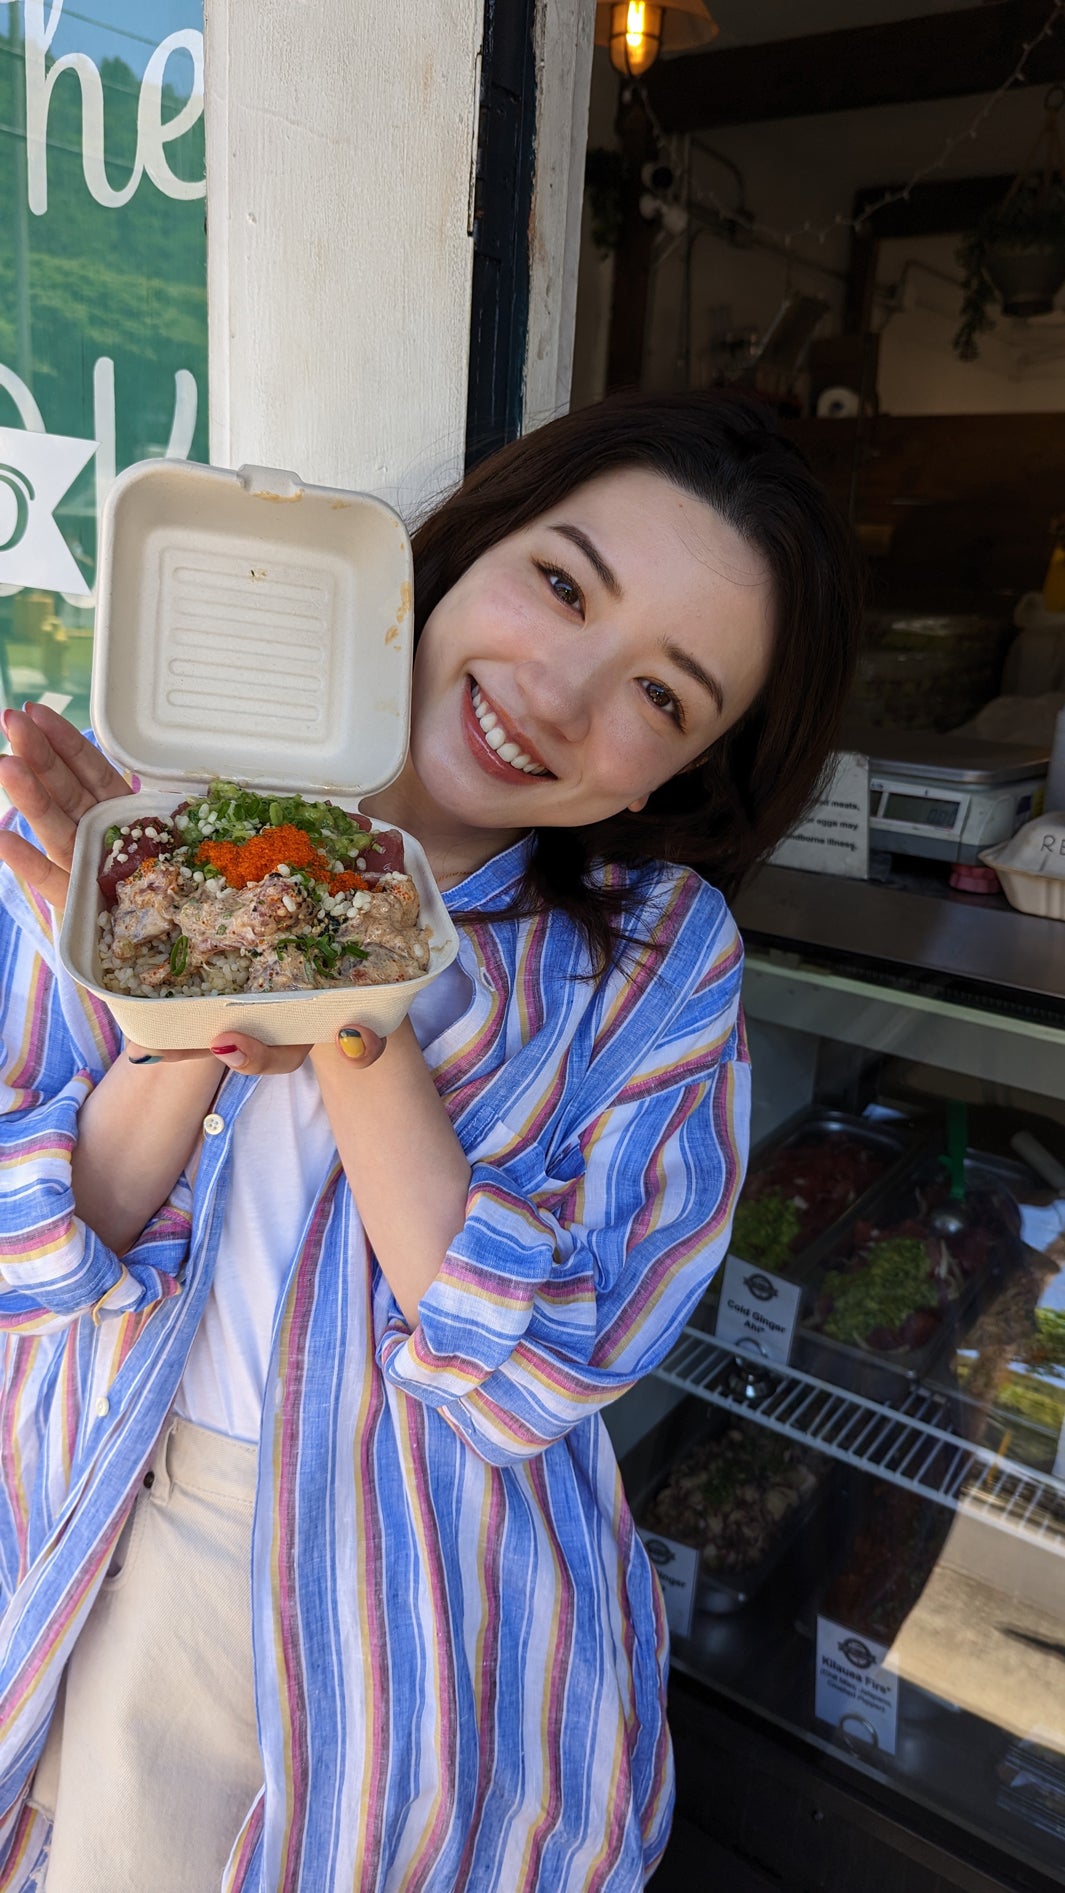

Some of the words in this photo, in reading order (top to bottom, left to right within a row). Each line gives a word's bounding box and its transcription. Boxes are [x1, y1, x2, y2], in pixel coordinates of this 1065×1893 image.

[816, 819, 837, 828] eggs
[839, 822, 859, 831] may
[752, 1312, 786, 1333] Ginger
